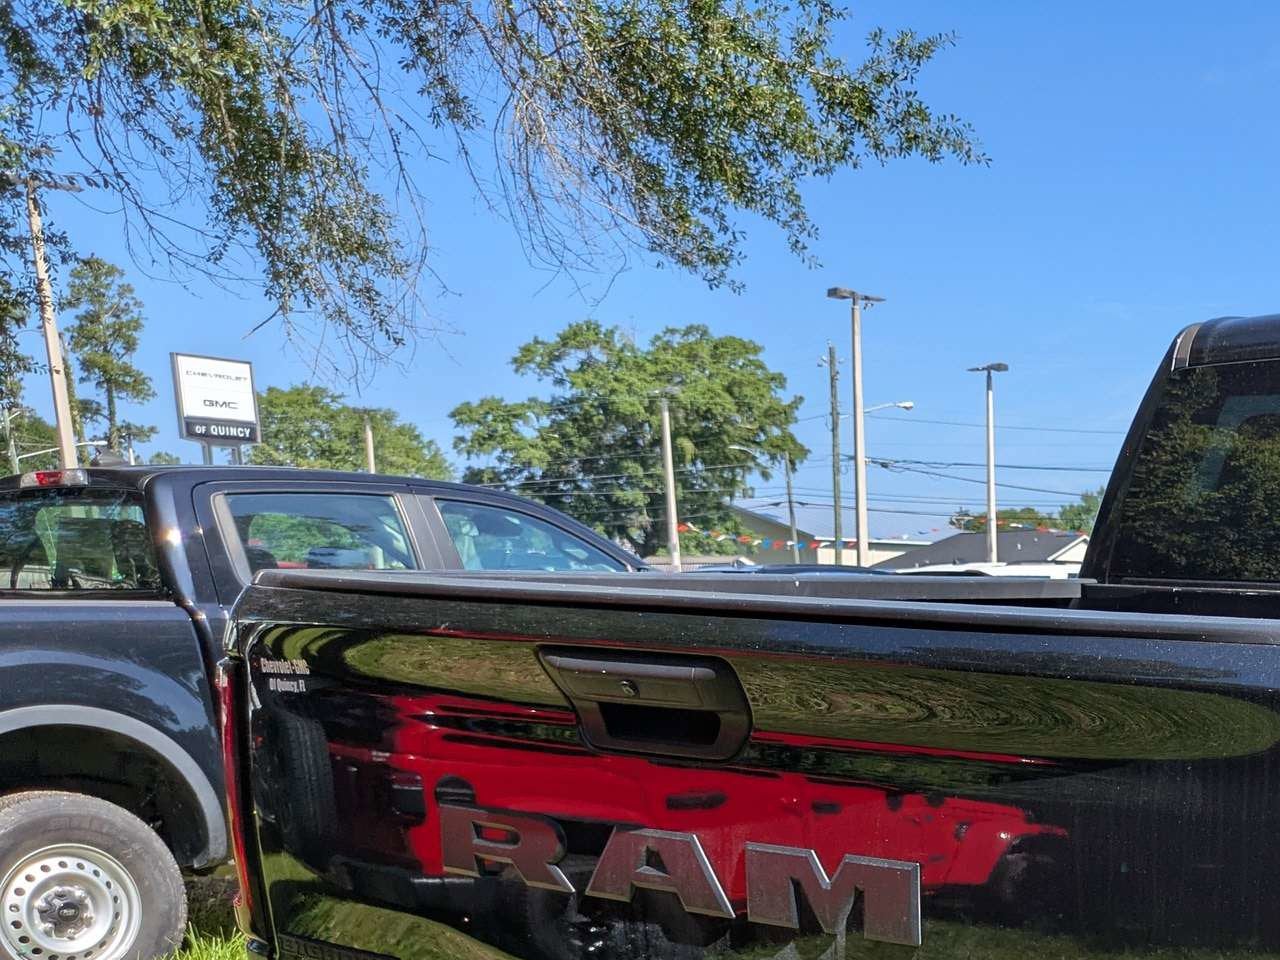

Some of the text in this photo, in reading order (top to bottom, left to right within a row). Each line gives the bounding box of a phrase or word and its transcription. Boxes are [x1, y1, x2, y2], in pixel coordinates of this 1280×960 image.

[185, 369, 249, 381] CHEVROLET
[203, 399, 239, 410] GMC
[195, 425, 251, 437] OF QUINCY
[440, 803, 922, 946] RAM
